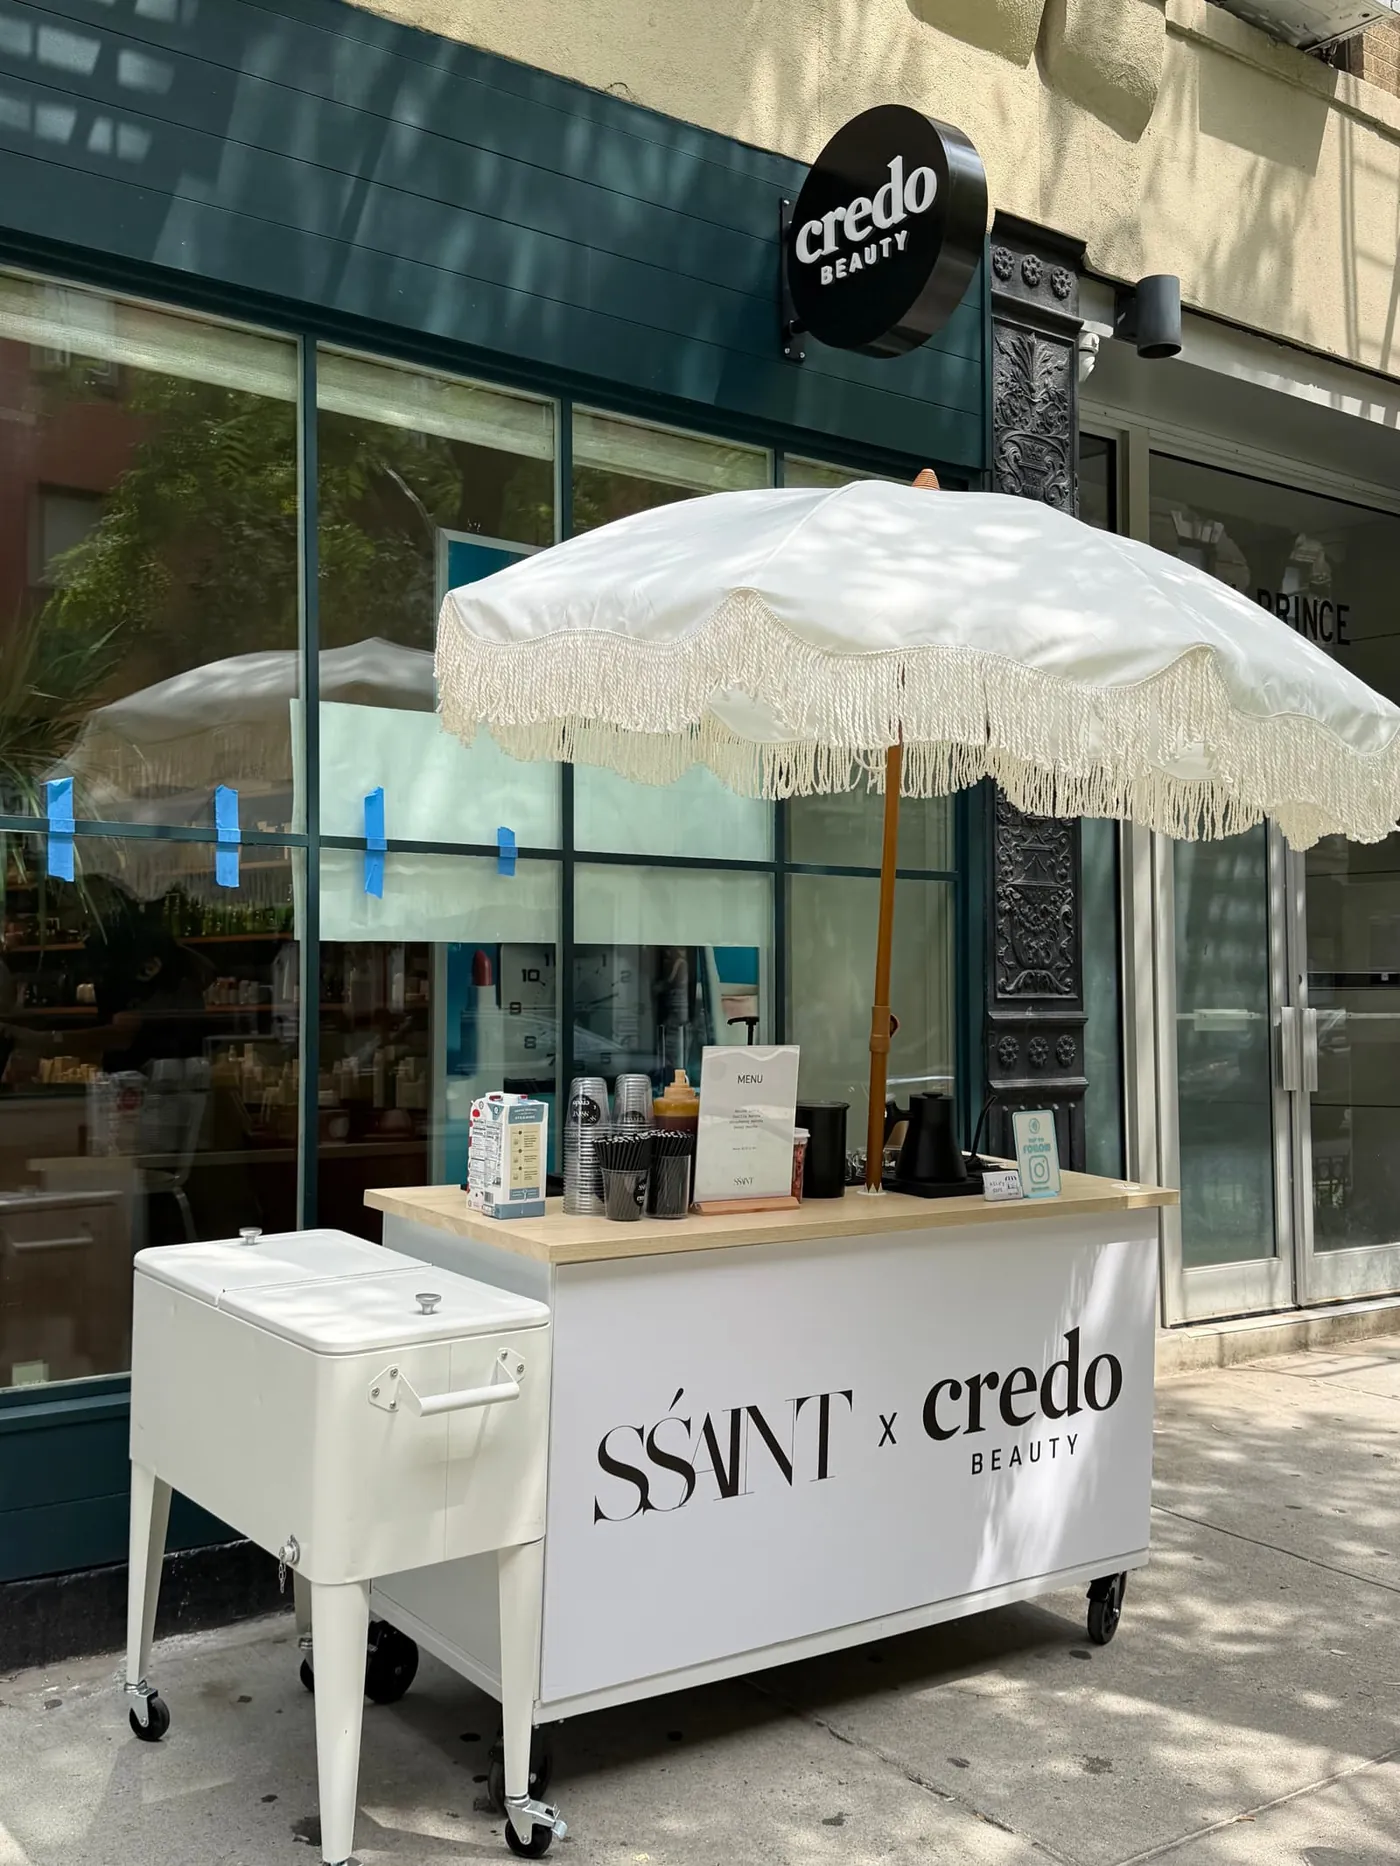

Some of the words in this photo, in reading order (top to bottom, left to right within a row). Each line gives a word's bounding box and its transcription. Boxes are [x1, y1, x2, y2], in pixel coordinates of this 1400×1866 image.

[795, 155, 938, 264] credo
[820, 230, 908, 286] BEAUTY
[521, 969, 541, 982] 10
[509, 1001, 522, 1015] 9
[524, 1036, 537, 1049] 8
[737, 1074, 763, 1085] MENU
[922, 1326, 1123, 1441] credo
[971, 1433, 1079, 1475] BEAUTY
